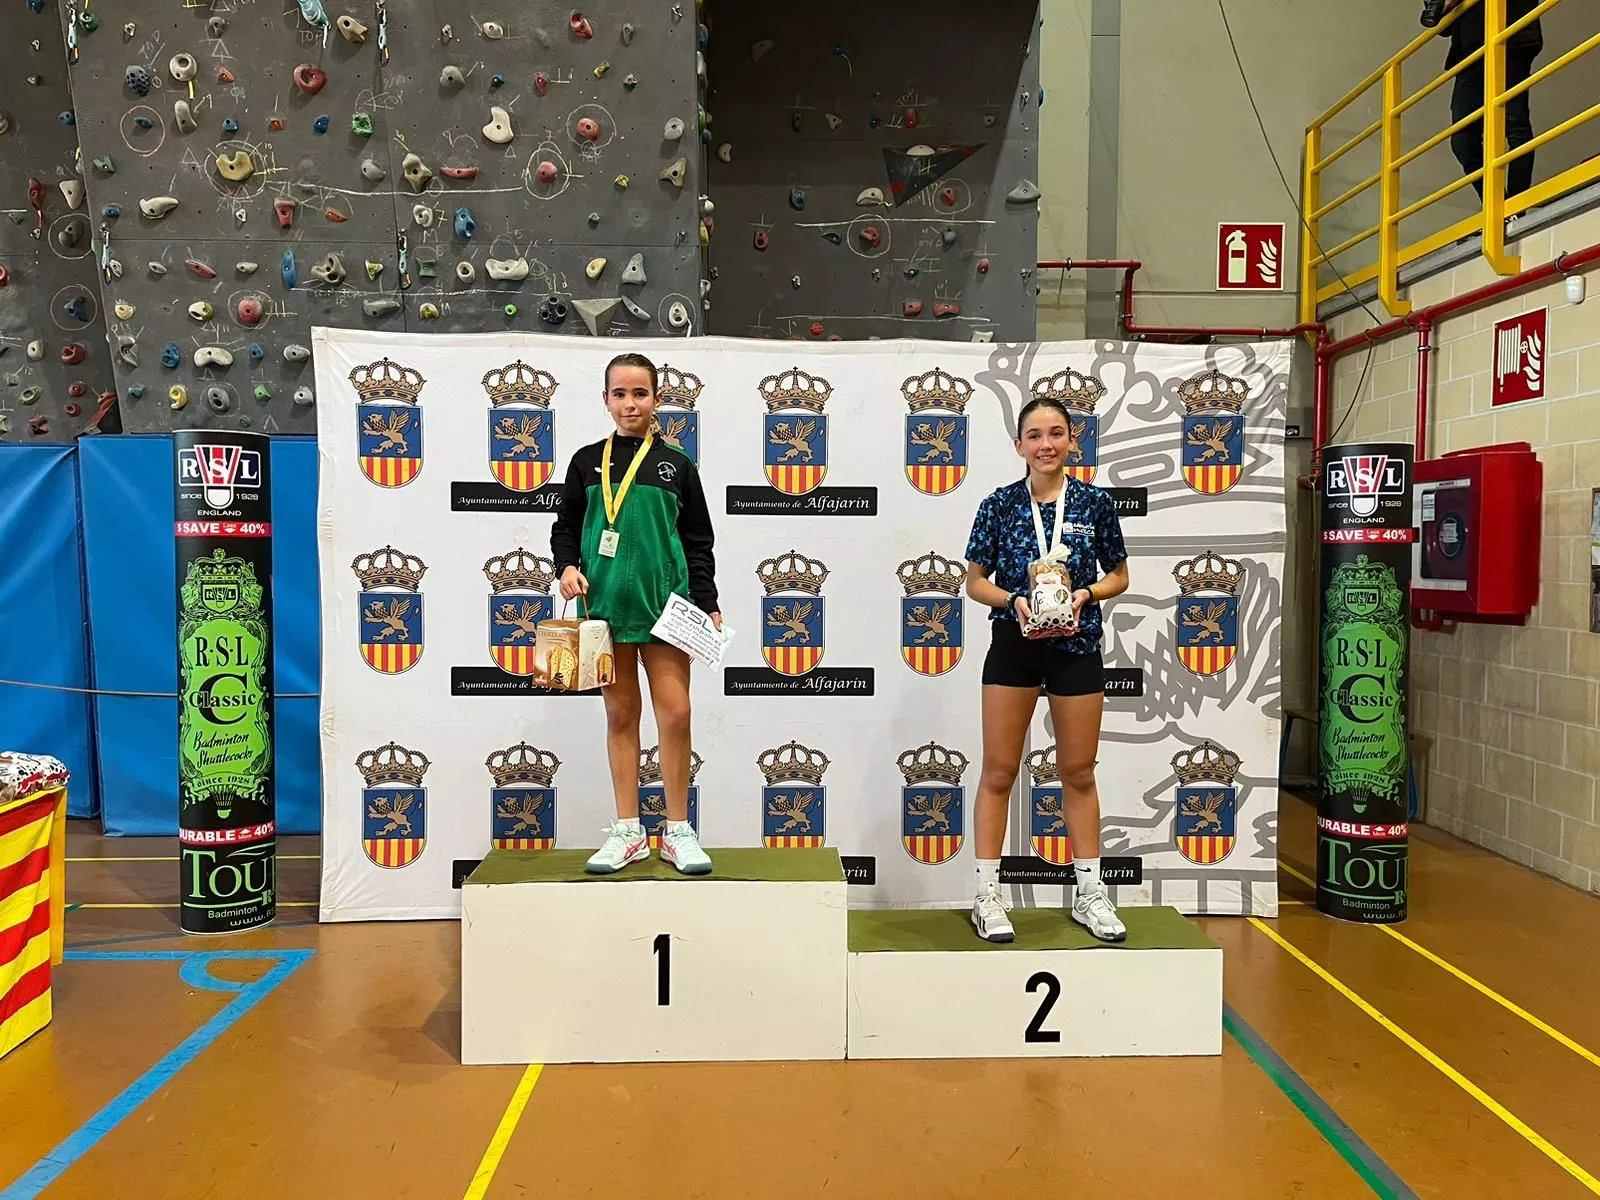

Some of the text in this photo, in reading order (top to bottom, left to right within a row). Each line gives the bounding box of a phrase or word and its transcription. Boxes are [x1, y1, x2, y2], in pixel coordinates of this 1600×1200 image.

[181, 457, 258, 480] RSL
[1330, 467, 1401, 488] RSL
[457, 496, 517, 506] Ayuntamiento
[732, 500, 790, 510] Ayuntamiento
[804, 495, 870, 512] Alfajarín
[182, 522, 220, 534] SAVE
[240, 523, 265, 534] 40%
[1329, 530, 1363, 540] SAVE
[1382, 530, 1407, 540] 40%
[671, 600, 712, 634] RSL
[457, 681, 517, 691] Ayuntamiento
[730, 681, 788, 691] Ayuntamiento
[802, 676, 867, 692] Alfajarín
[189, 690, 257, 708] Classic
[1330, 689, 1393, 707] Classic
[193, 731, 249, 752] Badminton
[1332, 727, 1385, 746] Badminton
[197, 749, 253, 769] Shuttlecocks
[1335, 745, 1389, 762] Shuttlecocks
[254, 822, 274, 836] 40%
[1388, 825, 1407, 836] 40%
[999, 869, 1057, 879] Ayuntamiento
[1342, 898, 1390, 910] Badminton
[208, 906, 258, 919] Badminton
[653, 933, 671, 1006] 1
[1024, 971, 1062, 1043] 2
